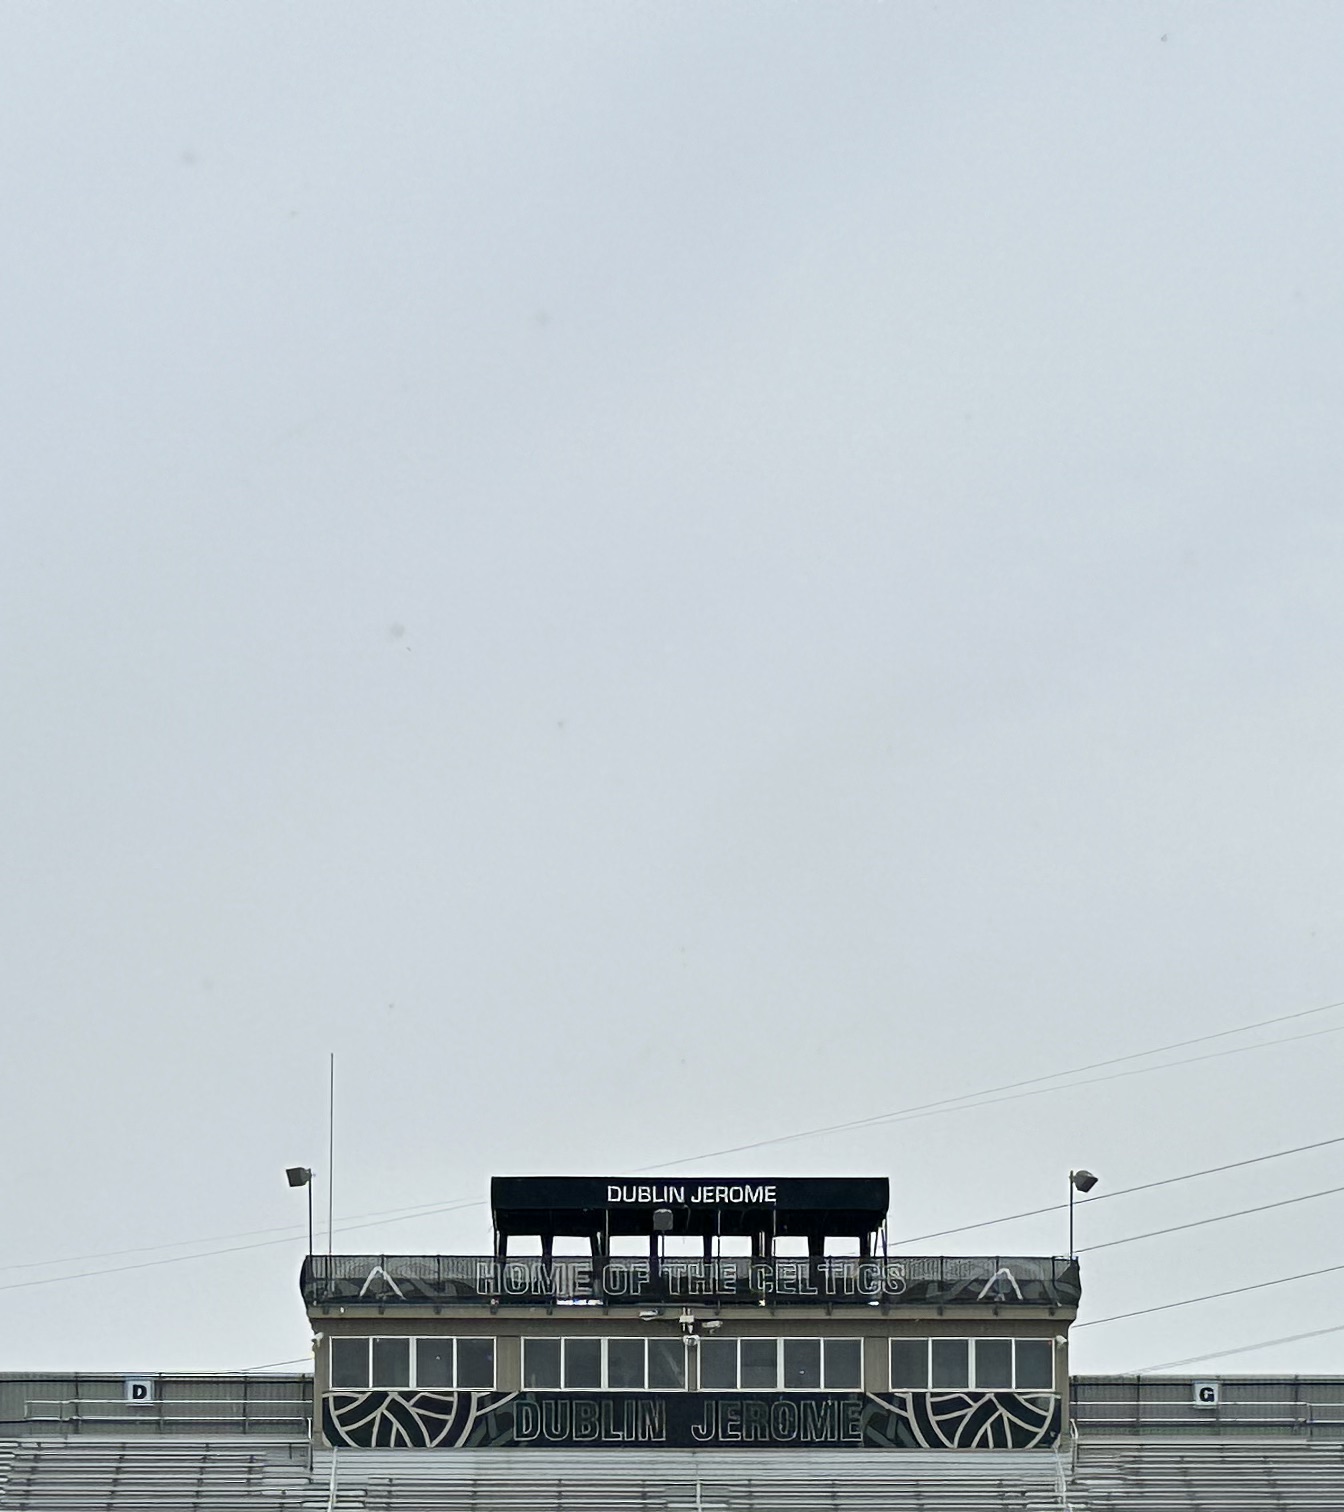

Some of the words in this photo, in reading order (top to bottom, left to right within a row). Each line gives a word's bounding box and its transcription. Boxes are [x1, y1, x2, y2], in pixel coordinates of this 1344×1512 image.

[607, 1184, 685, 1203] DUBLIN
[690, 1184, 777, 1203] JEROME
[477, 1260, 593, 1297] HOME
[601, 1260, 651, 1297] OF
[659, 1260, 737, 1297] THE
[750, 1260, 908, 1297] CELTICS
[133, 1384, 148, 1400] D
[1199, 1387, 1215, 1402] G
[513, 1399, 667, 1442] DUBLIN
[690, 1399, 864, 1442] JEROME
